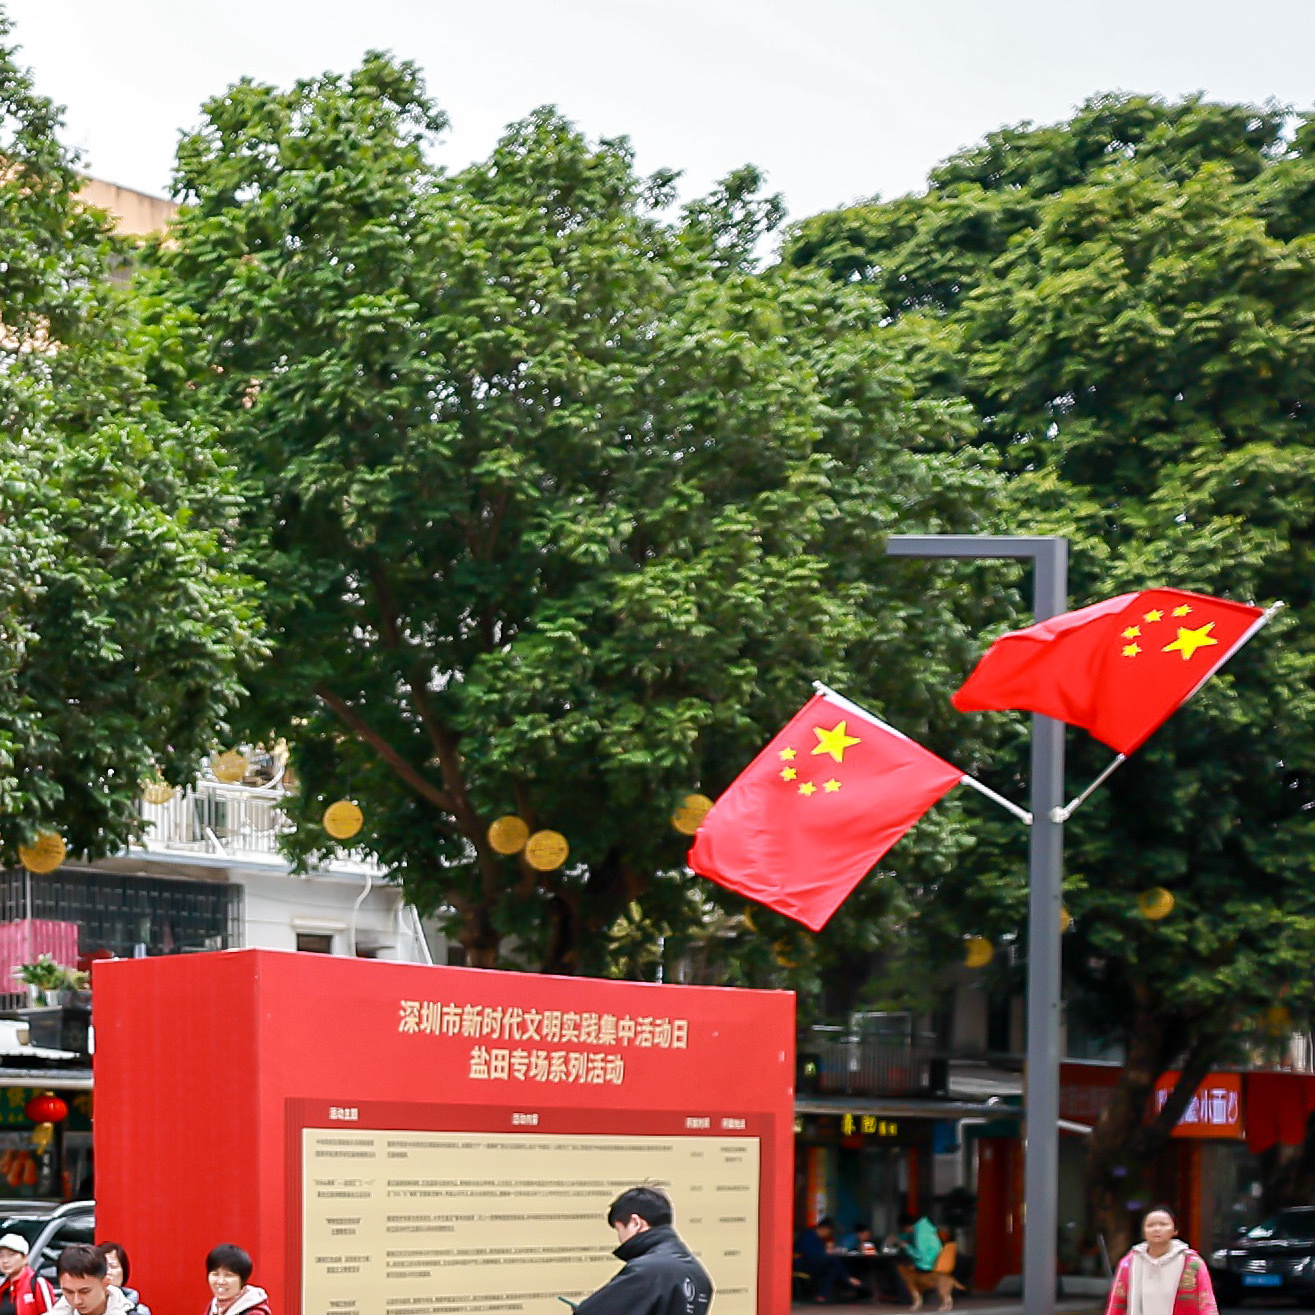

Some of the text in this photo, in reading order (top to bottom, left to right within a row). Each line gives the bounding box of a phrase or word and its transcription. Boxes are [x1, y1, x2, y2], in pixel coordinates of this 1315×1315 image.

[398, 999, 689, 1049] 深圳市新时代文明实践集中活动日
[468, 1046, 625, 1085] 盐田专场系列活动
